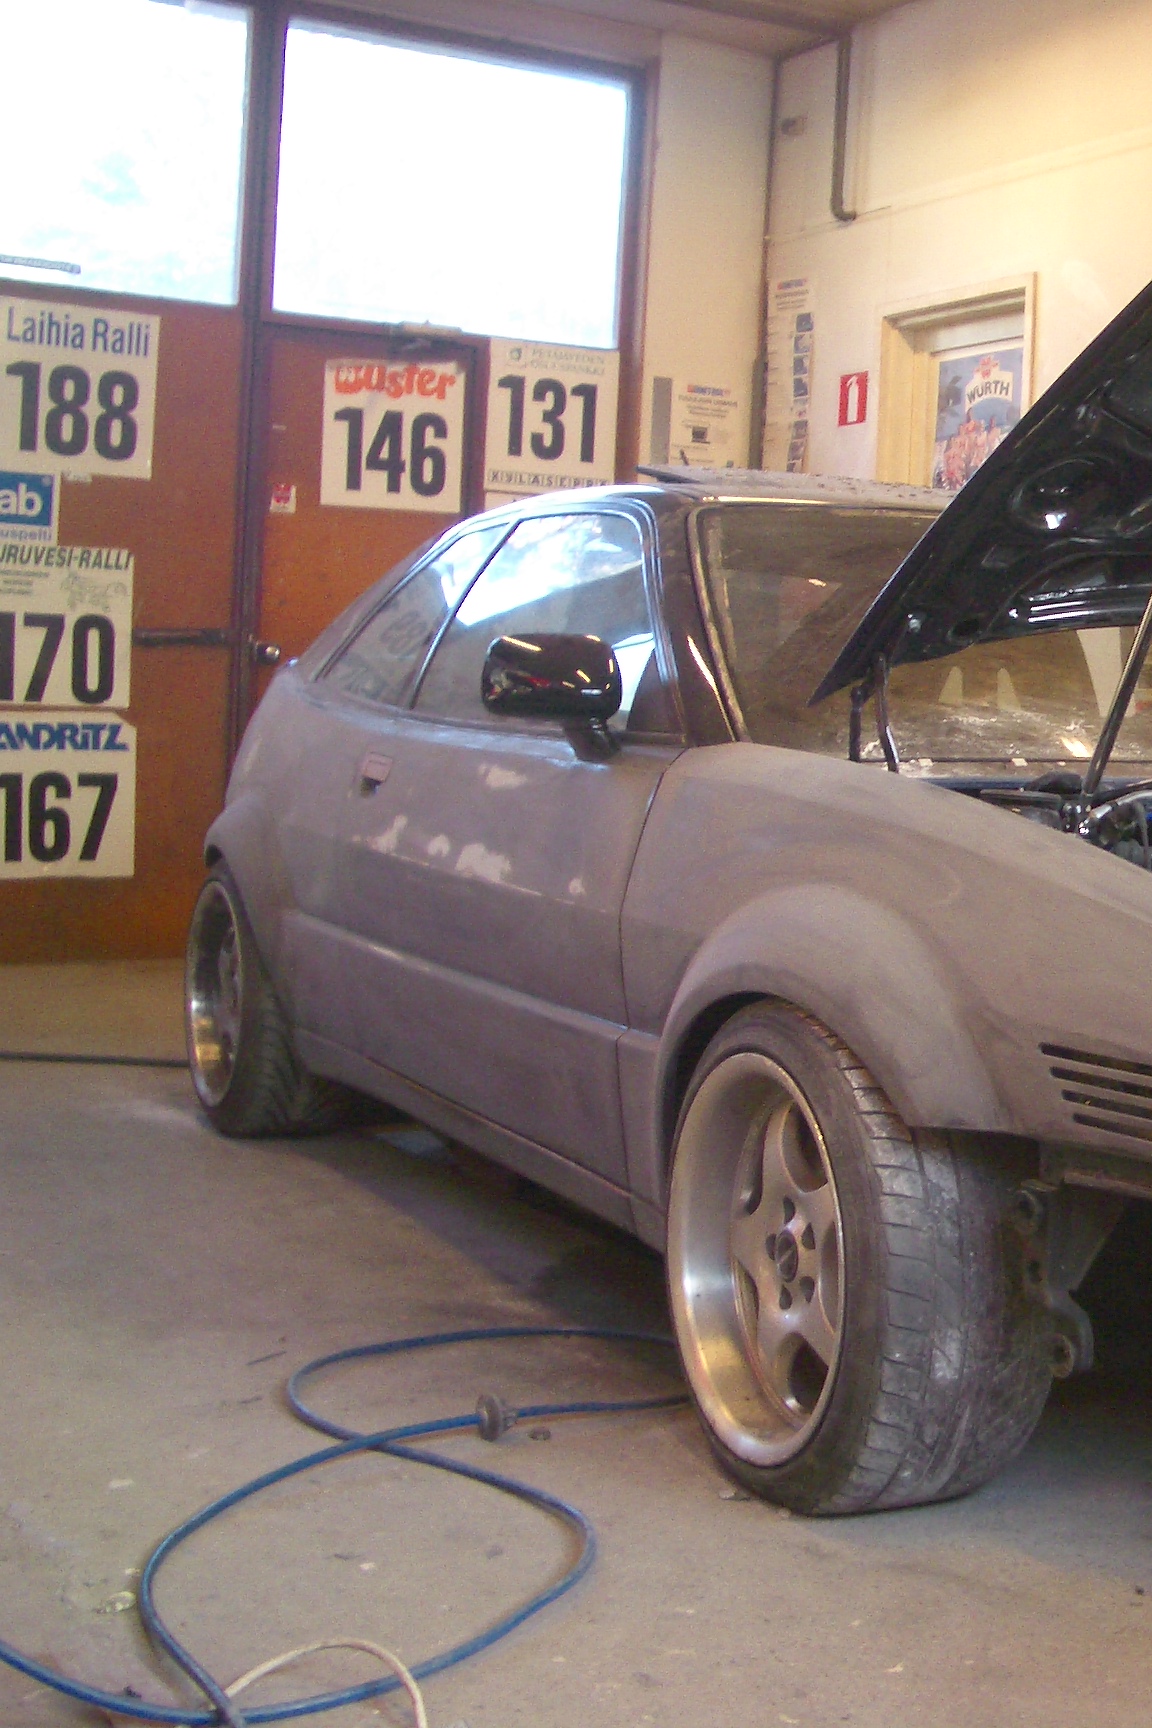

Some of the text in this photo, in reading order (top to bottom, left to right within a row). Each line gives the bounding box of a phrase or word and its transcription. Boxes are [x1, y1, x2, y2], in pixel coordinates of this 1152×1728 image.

[7, 306, 150, 357] Laihia Ralli
[6, 361, 139, 461] 188
[334, 407, 448, 497] 146
[498, 374, 598, 463] 131
[0, 772, 118, 862] 167
